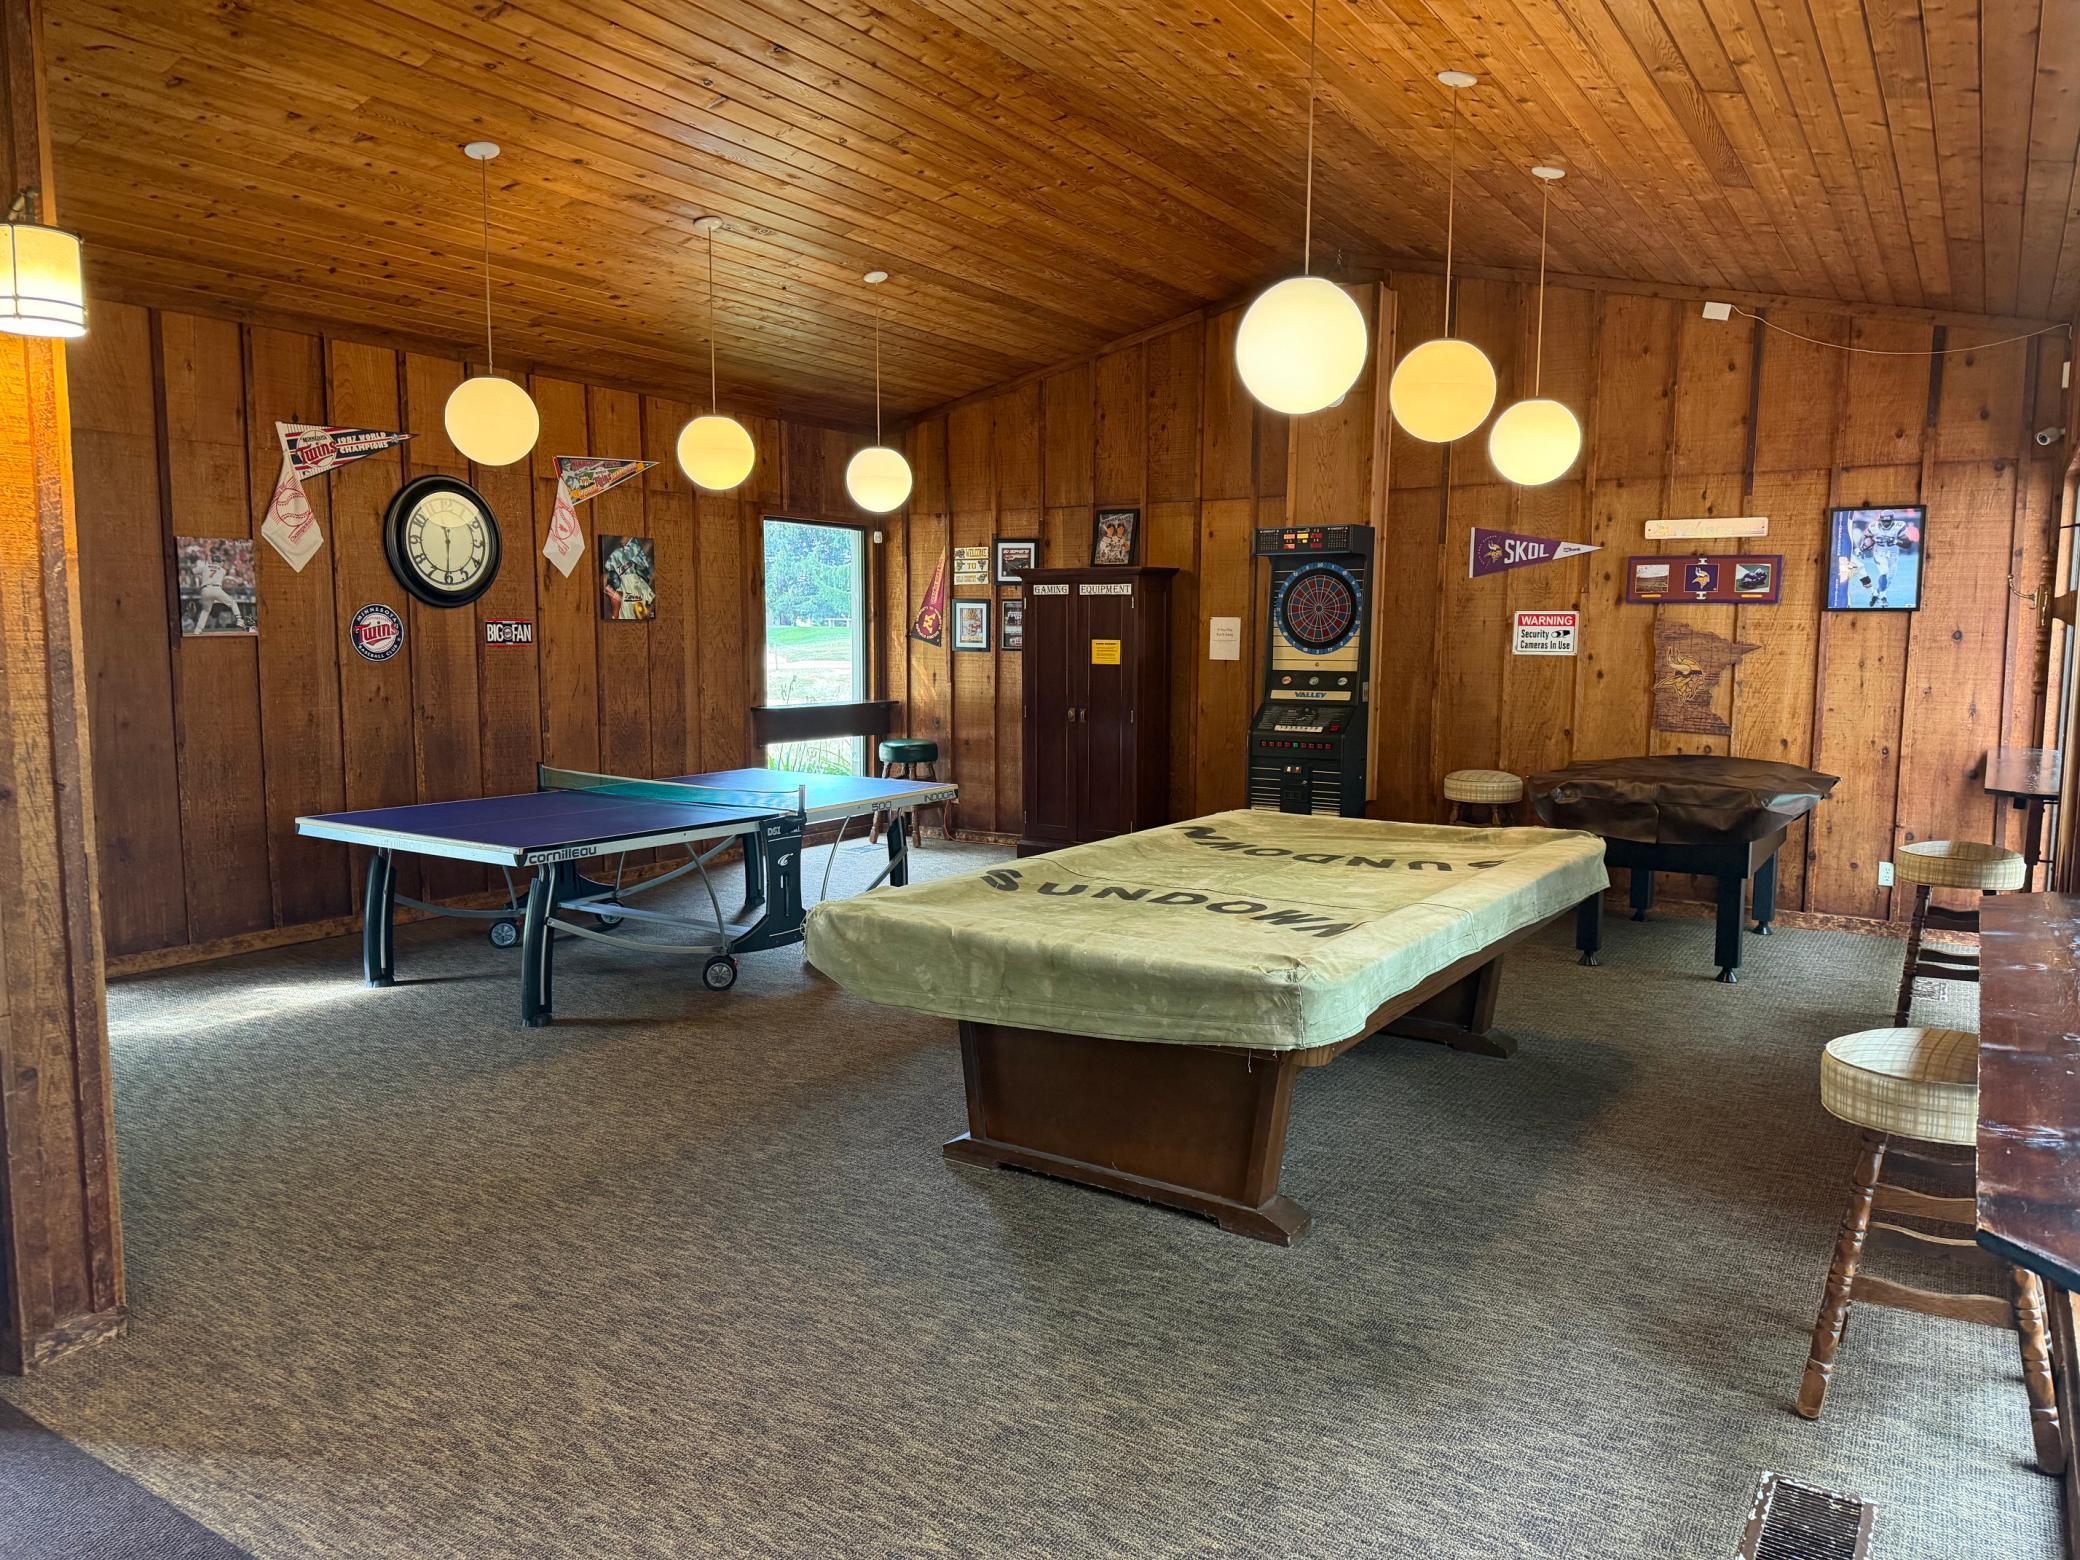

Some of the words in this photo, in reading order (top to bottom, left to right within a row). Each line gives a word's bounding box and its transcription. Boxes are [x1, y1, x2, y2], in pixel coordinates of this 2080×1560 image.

[337, 436, 357, 444] 1987
[358, 432, 387, 441] WORLD
[296, 441, 337, 464] Twins
[340, 441, 389, 453] CHAMPIONS
[1504, 539, 1550, 564] SKOL
[210, 569, 217, 578] 7
[444, 571, 454, 584] 6
[1034, 586, 1068, 594] GAMING
[1081, 585, 1130, 594] EQUIPMENT
[357, 607, 397, 622] MINNESOTA
[1521, 616, 1573, 625] WARNING
[353, 621, 399, 644] Twins
[487, 624, 504, 642] BIG
[512, 624, 531, 642] FAN
[1521, 629, 1549, 640] Security
[1520, 640, 1548, 650] Cameras
[1550, 640, 1557, 650] In
[1558, 640, 1570, 650] Use
[358, 645, 384, 659] BASEBALL
[386, 644, 398, 656] CLUB
[923, 791, 956, 802] INDOOR
[871, 801, 892, 811] 500
[528, 846, 597, 864] cornilleau
[980, 868, 1362, 938] SUNDOWN
